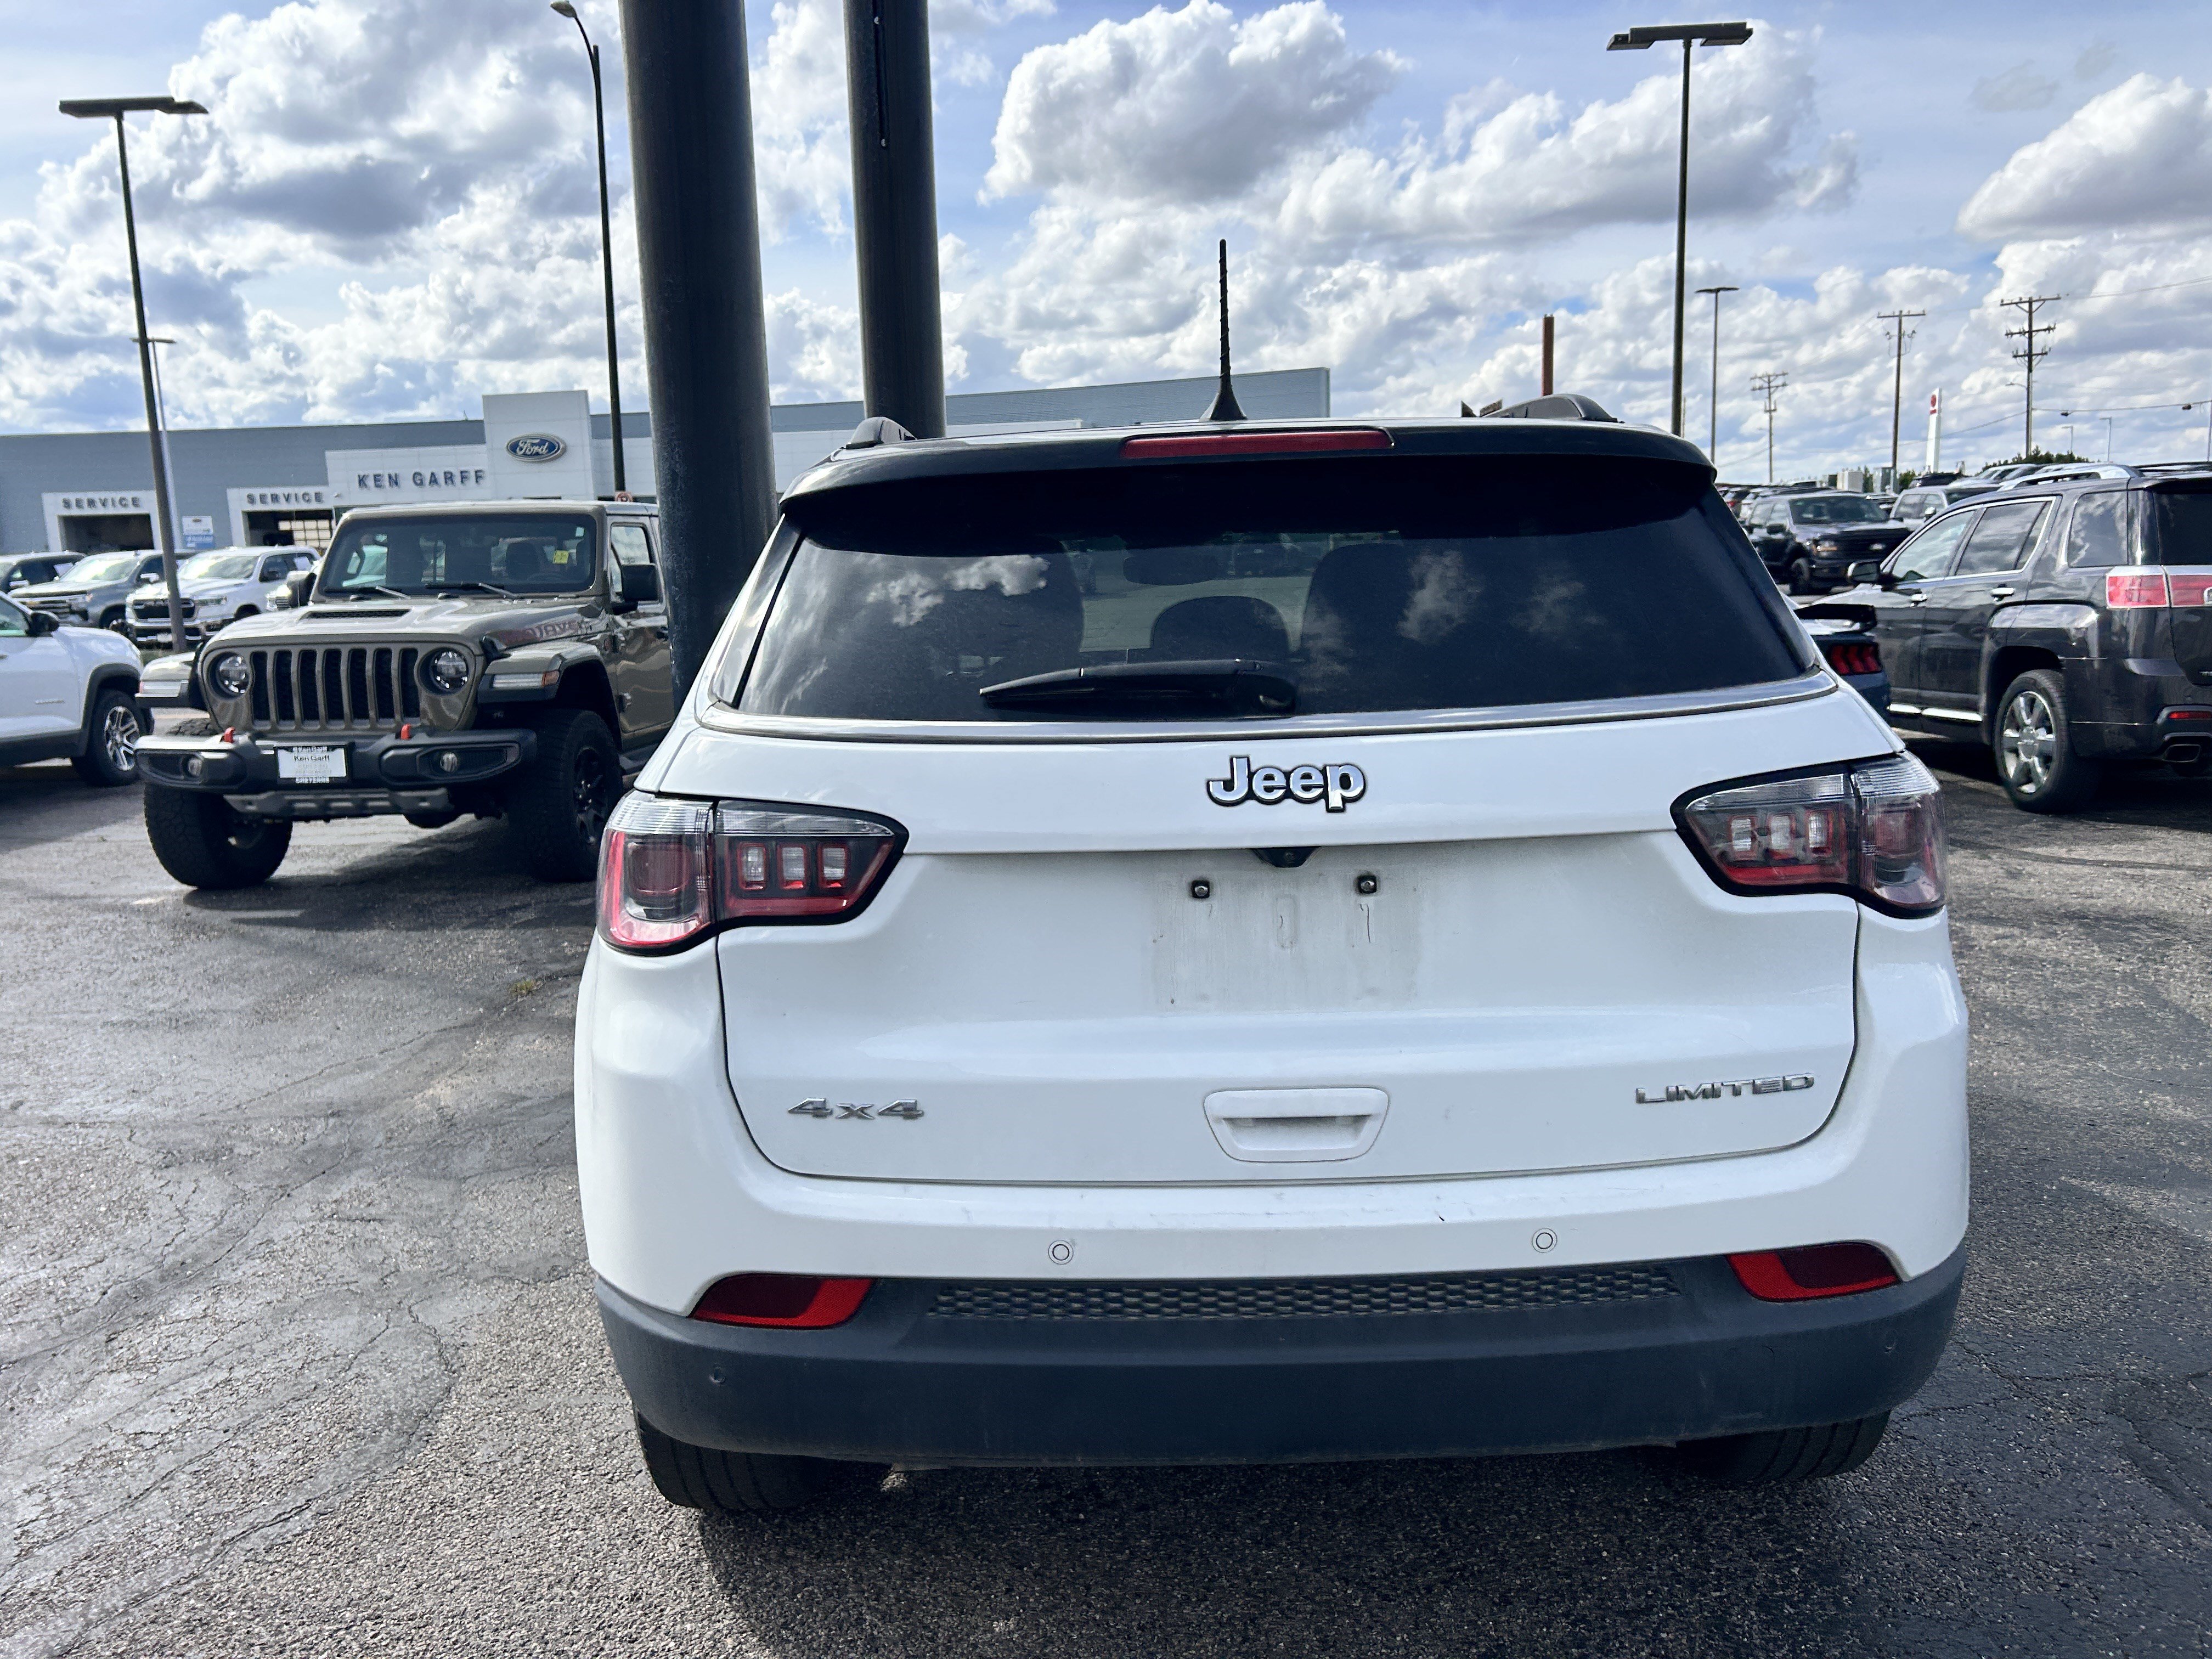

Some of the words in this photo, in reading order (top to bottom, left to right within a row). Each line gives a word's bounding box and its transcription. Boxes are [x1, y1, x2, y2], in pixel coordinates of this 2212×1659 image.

[517, 438, 549, 455] Ford
[358, 473, 399, 488] KEN
[413, 470, 484, 487] GARFF
[62, 496, 140, 510] SERVICE
[247, 492, 324, 505] SERVICE
[1207, 755, 1366, 812] Jeep
[1635, 1073, 1814, 1104] LIMITED
